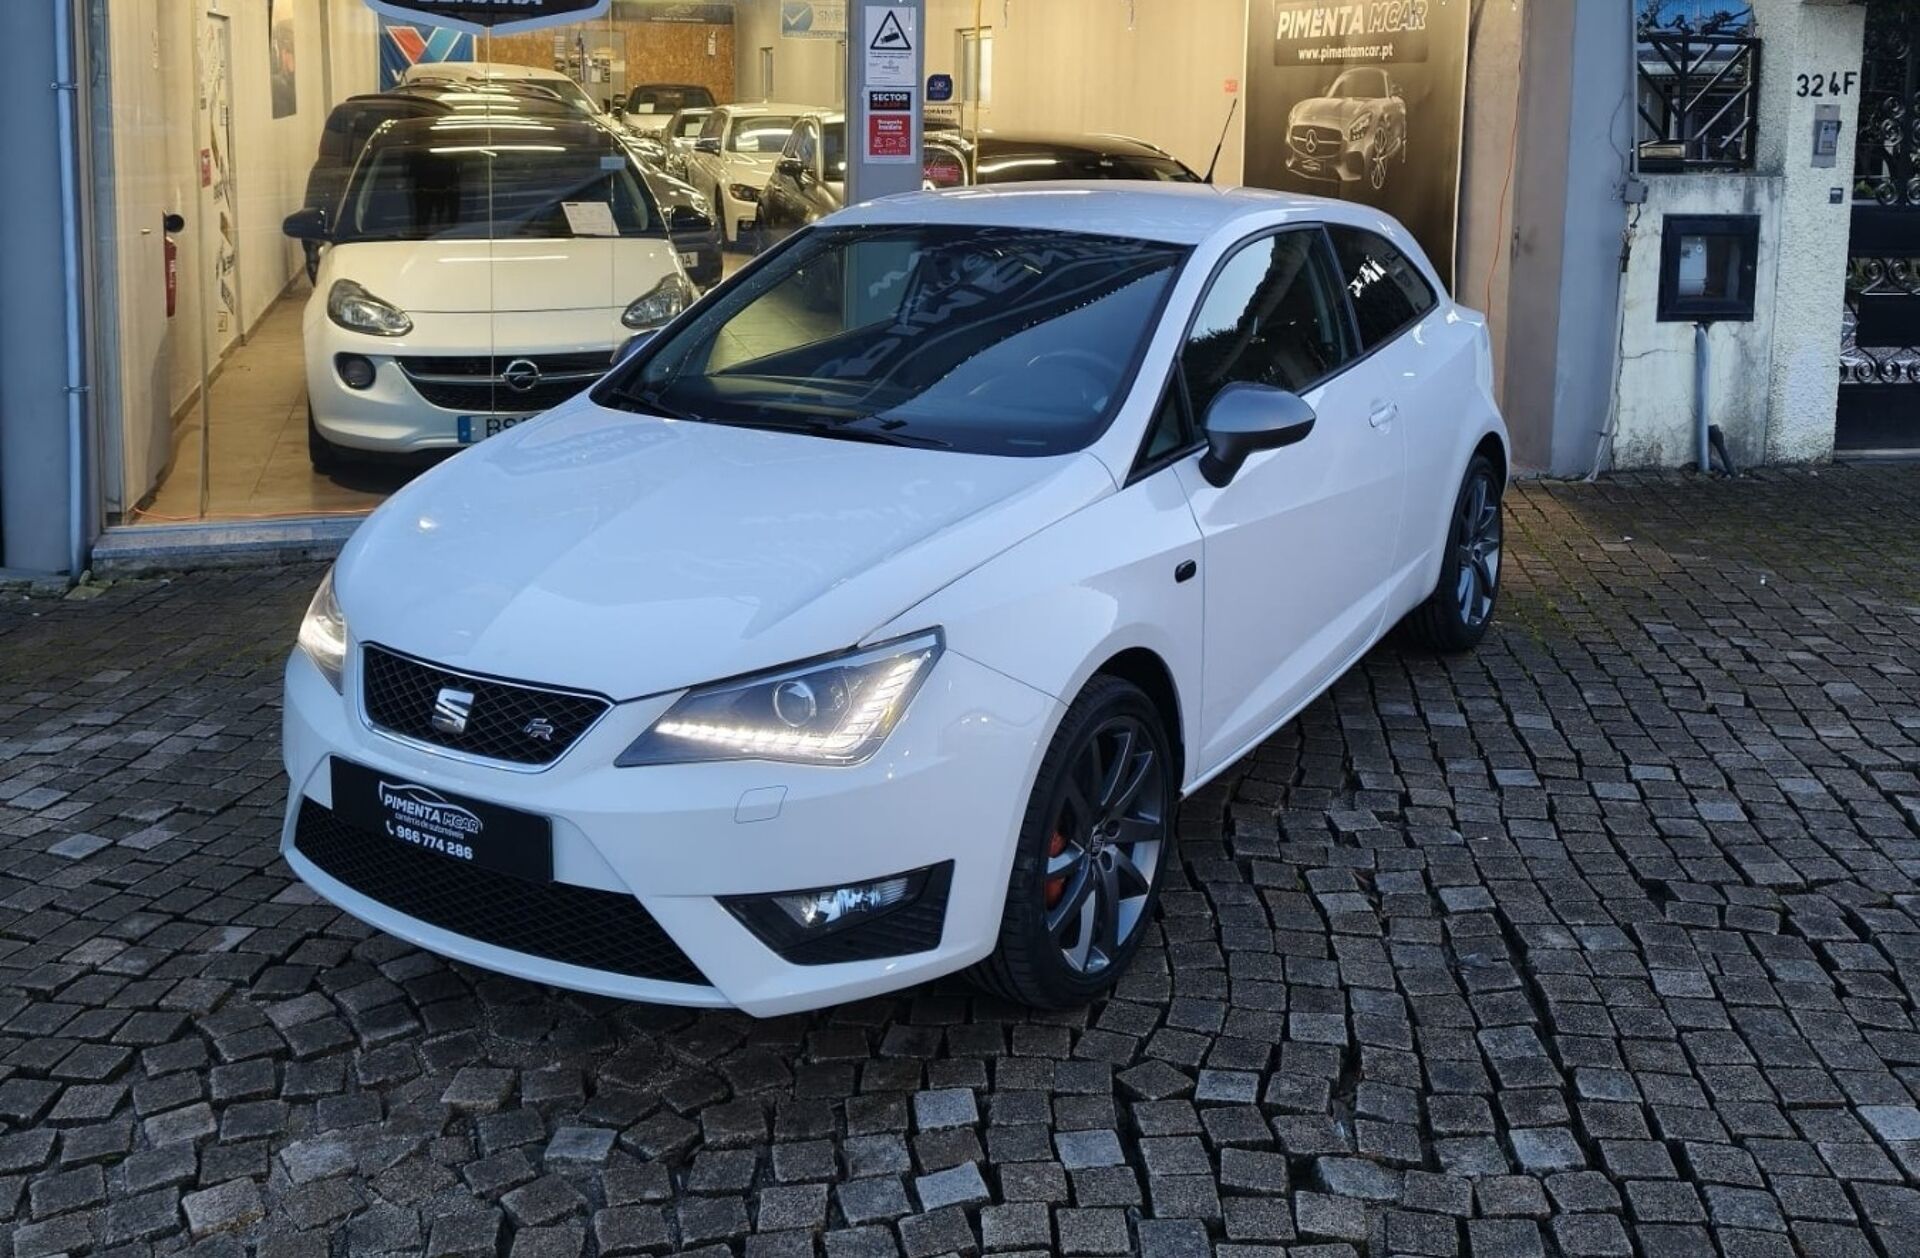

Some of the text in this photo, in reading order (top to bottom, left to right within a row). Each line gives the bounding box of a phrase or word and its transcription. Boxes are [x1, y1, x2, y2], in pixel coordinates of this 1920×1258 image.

[1276, 0, 1429, 40] PIMENTA MCAR
[1298, 42, 1393, 62] www.pimentamcar.pt
[871, 93, 908, 102] SECTOR
[1796, 71, 1858, 98] 324F
[384, 794, 479, 834] PIMENTA MCAR
[422, 833, 445, 852] 774
[446, 841, 474, 860] 286
